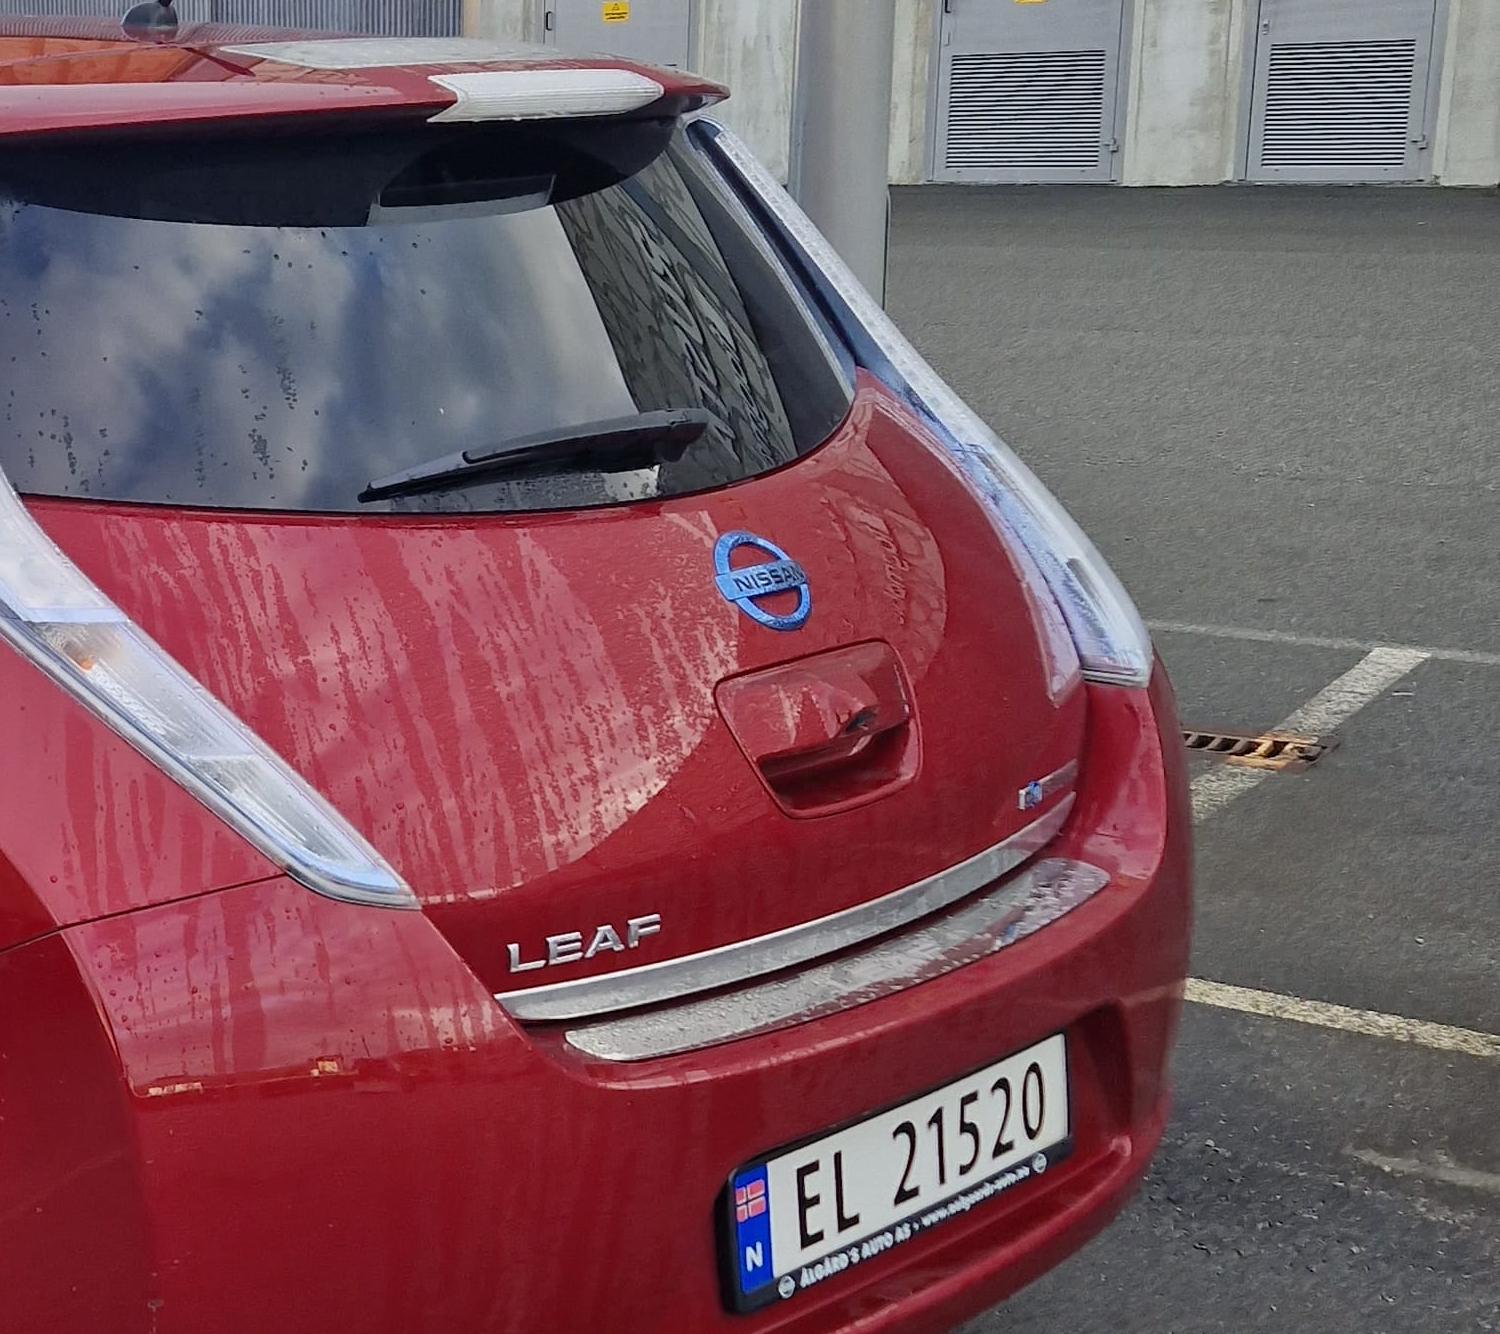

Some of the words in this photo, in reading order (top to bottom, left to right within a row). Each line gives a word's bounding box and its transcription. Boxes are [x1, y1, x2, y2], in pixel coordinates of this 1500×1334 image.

[733, 563, 805, 593] NISSAN
[507, 914, 661, 973] LEAF
[795, 1149, 860, 1252] EL
[891, 1061, 1046, 1207] 21520
[744, 1240, 764, 1273] N
